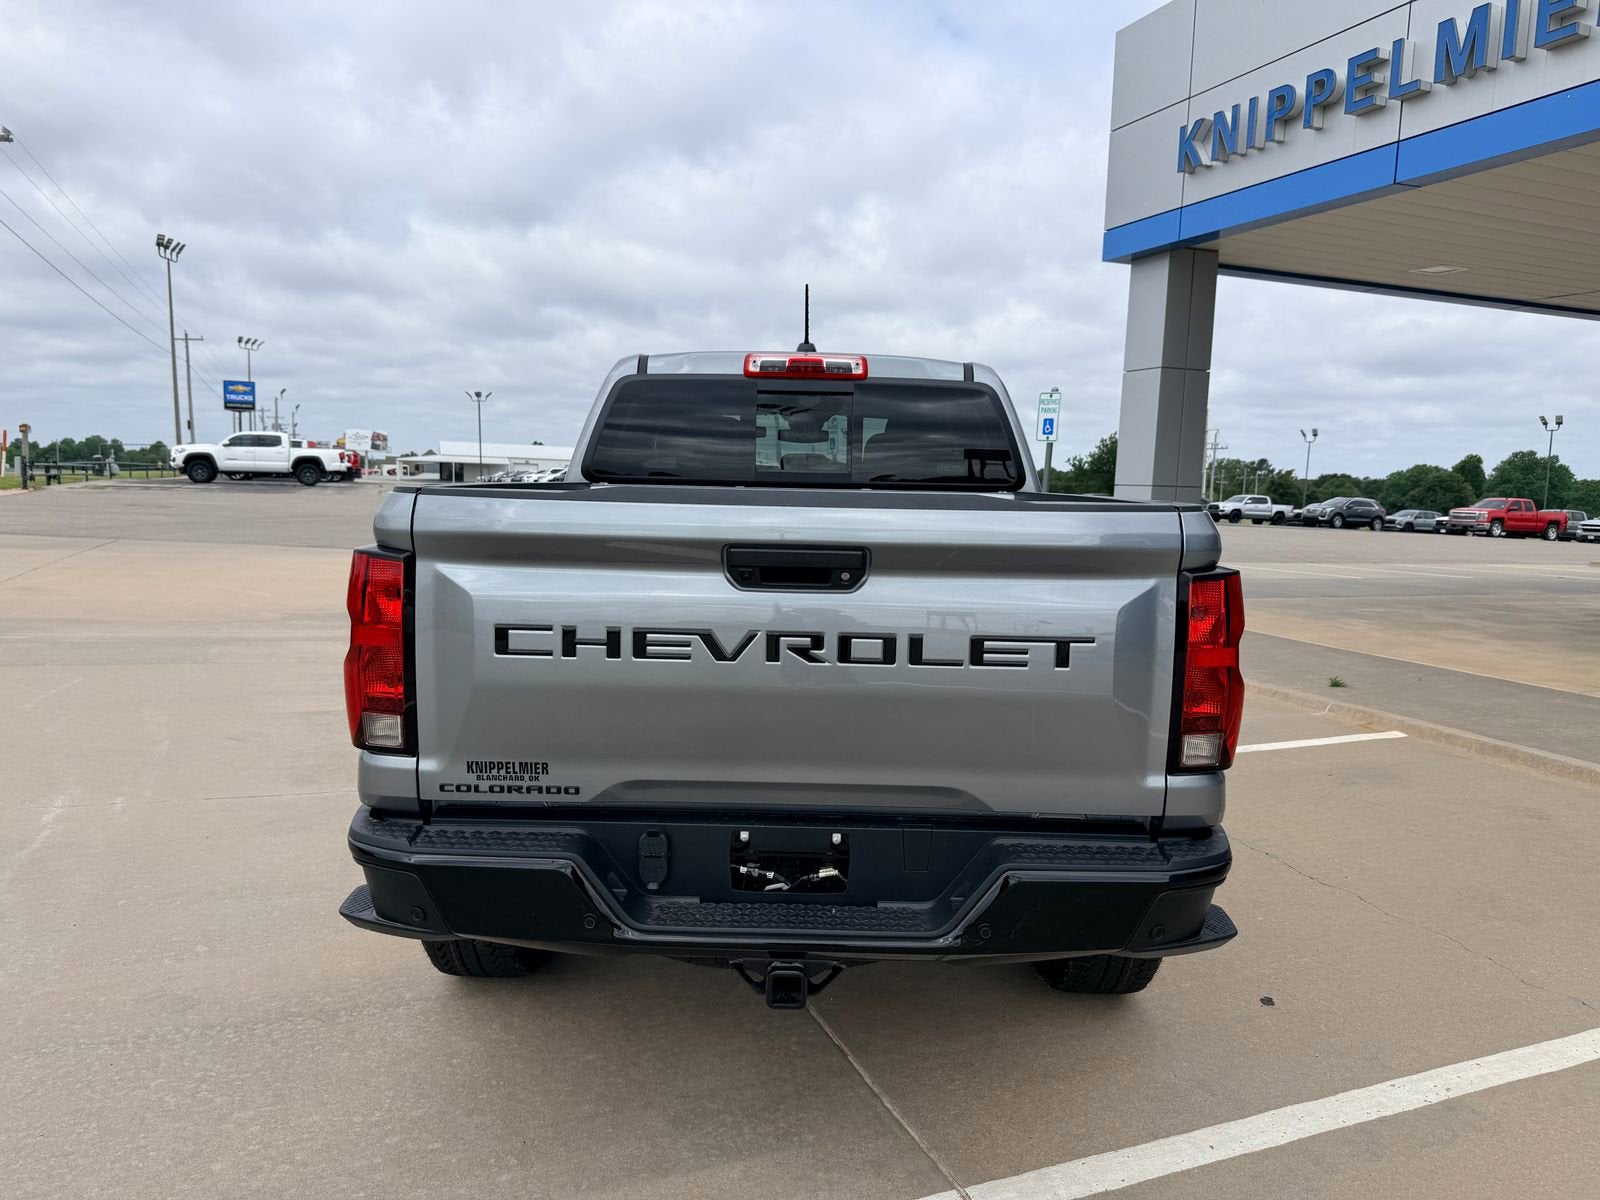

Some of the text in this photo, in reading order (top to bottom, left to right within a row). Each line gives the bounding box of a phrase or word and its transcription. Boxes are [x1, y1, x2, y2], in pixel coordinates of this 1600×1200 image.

[1177, 0, 1600, 174] KNIPPELMIE
[494, 623, 1096, 671] CHEVROLET
[466, 760, 549, 775] KNIPPELMIER
[476, 774, 527, 782] BLANCHARD,
[439, 783, 580, 795] COLORADO
